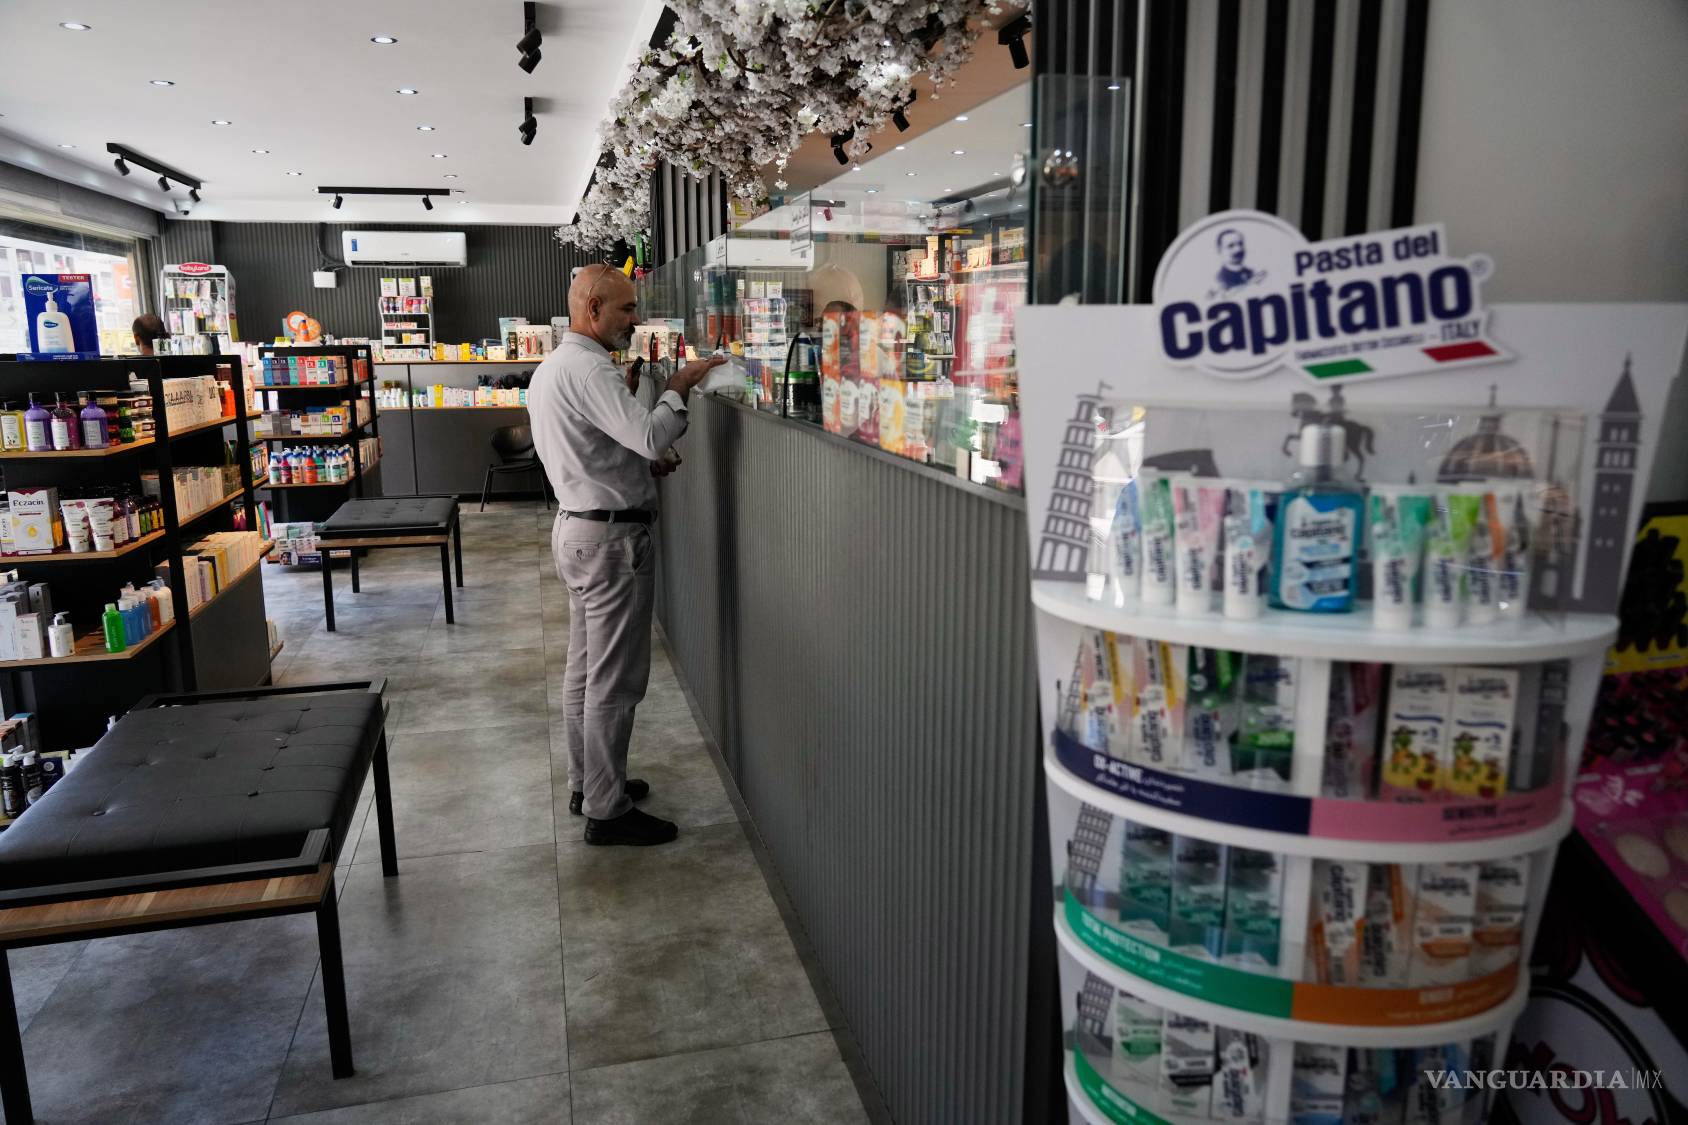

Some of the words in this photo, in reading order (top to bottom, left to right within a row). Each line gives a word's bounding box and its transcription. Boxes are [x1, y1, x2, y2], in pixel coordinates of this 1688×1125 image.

[1295, 241, 1384, 277] Pasta
[1394, 231, 1440, 262] del
[1160, 264, 1473, 360] Capitano
[1440, 319, 1481, 341] ITALY
[13, 499, 45, 507] Eczacin
